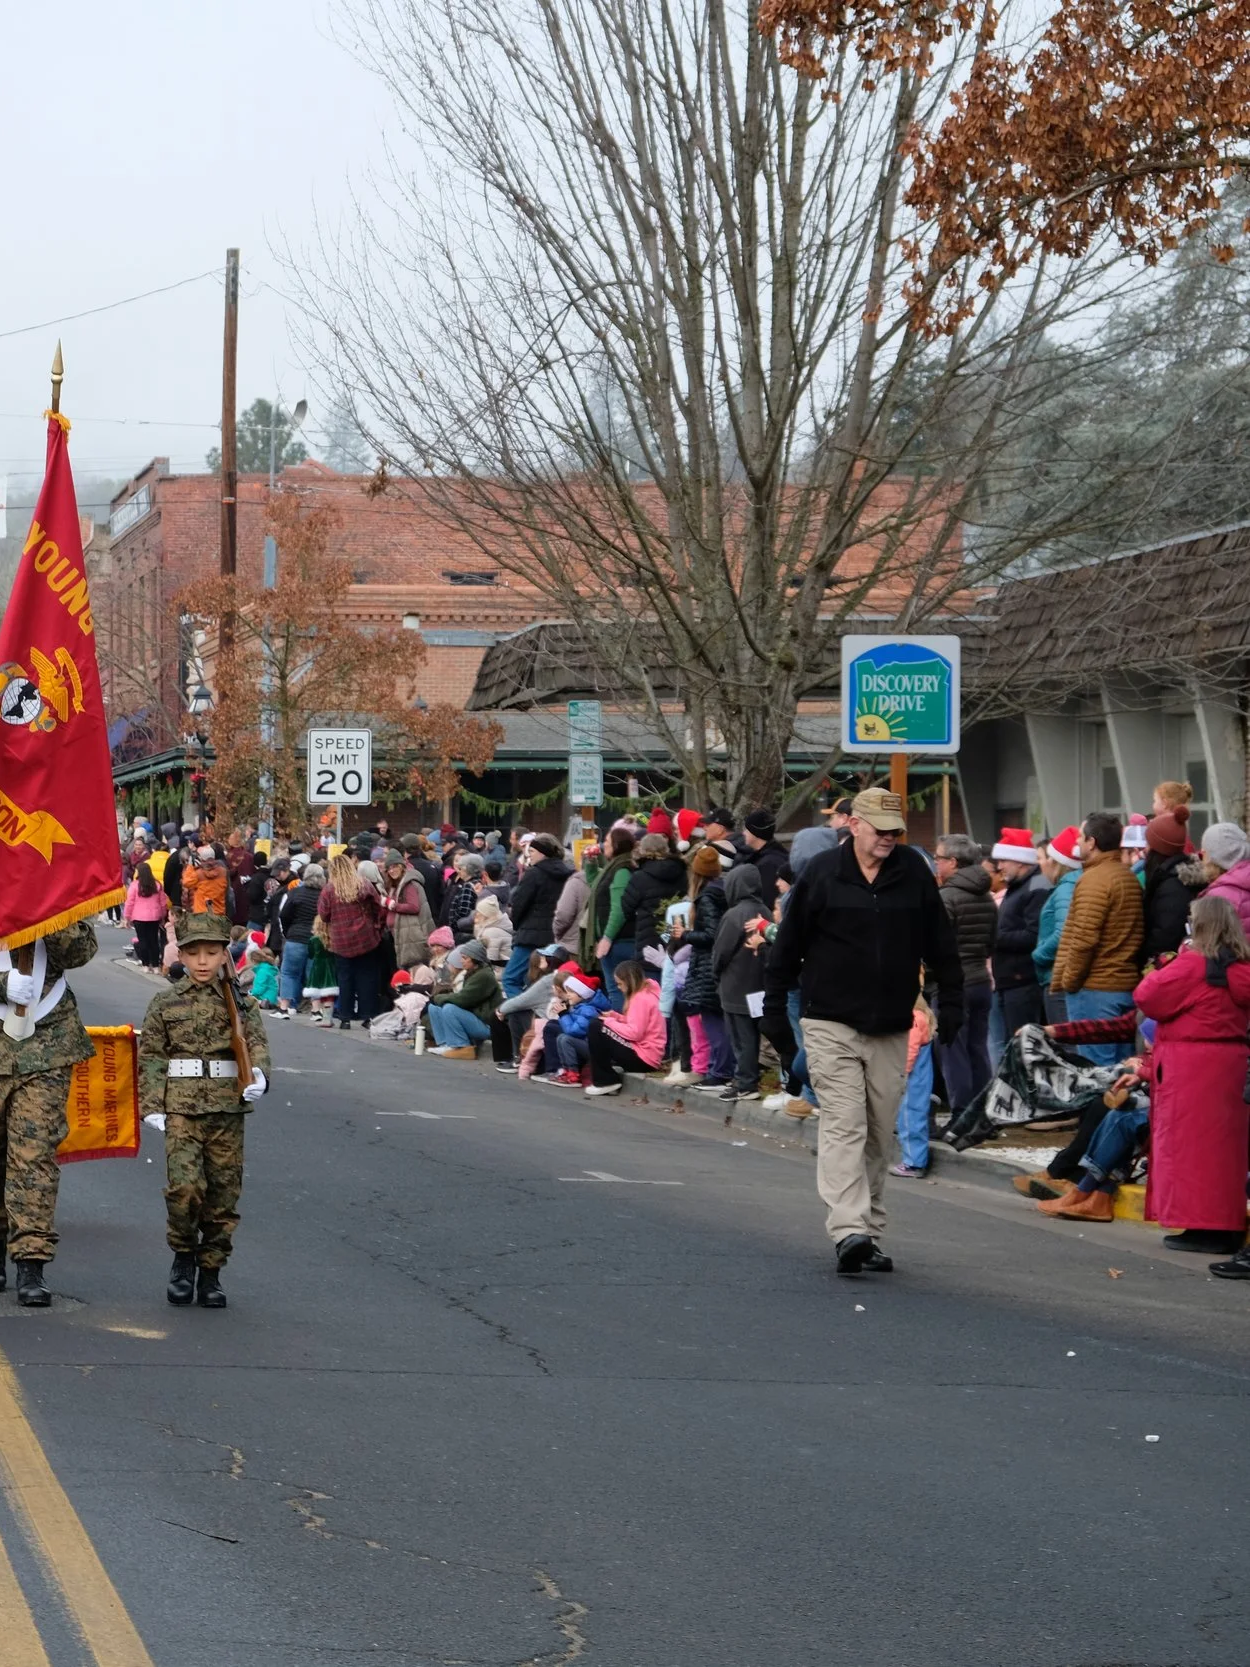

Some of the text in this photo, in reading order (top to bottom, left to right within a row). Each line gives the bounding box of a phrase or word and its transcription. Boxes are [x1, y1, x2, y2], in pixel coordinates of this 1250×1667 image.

[861, 674, 941, 693] DISCOVERY
[877, 694, 926, 712] DRIVE
[315, 737, 365, 749] SPEED
[320, 753, 359, 765] LIMIT
[316, 769, 362, 795] 20
[75, 1059, 91, 1128] SOUTHERN
[102, 1039, 119, 1143] YOUNG MARINES
